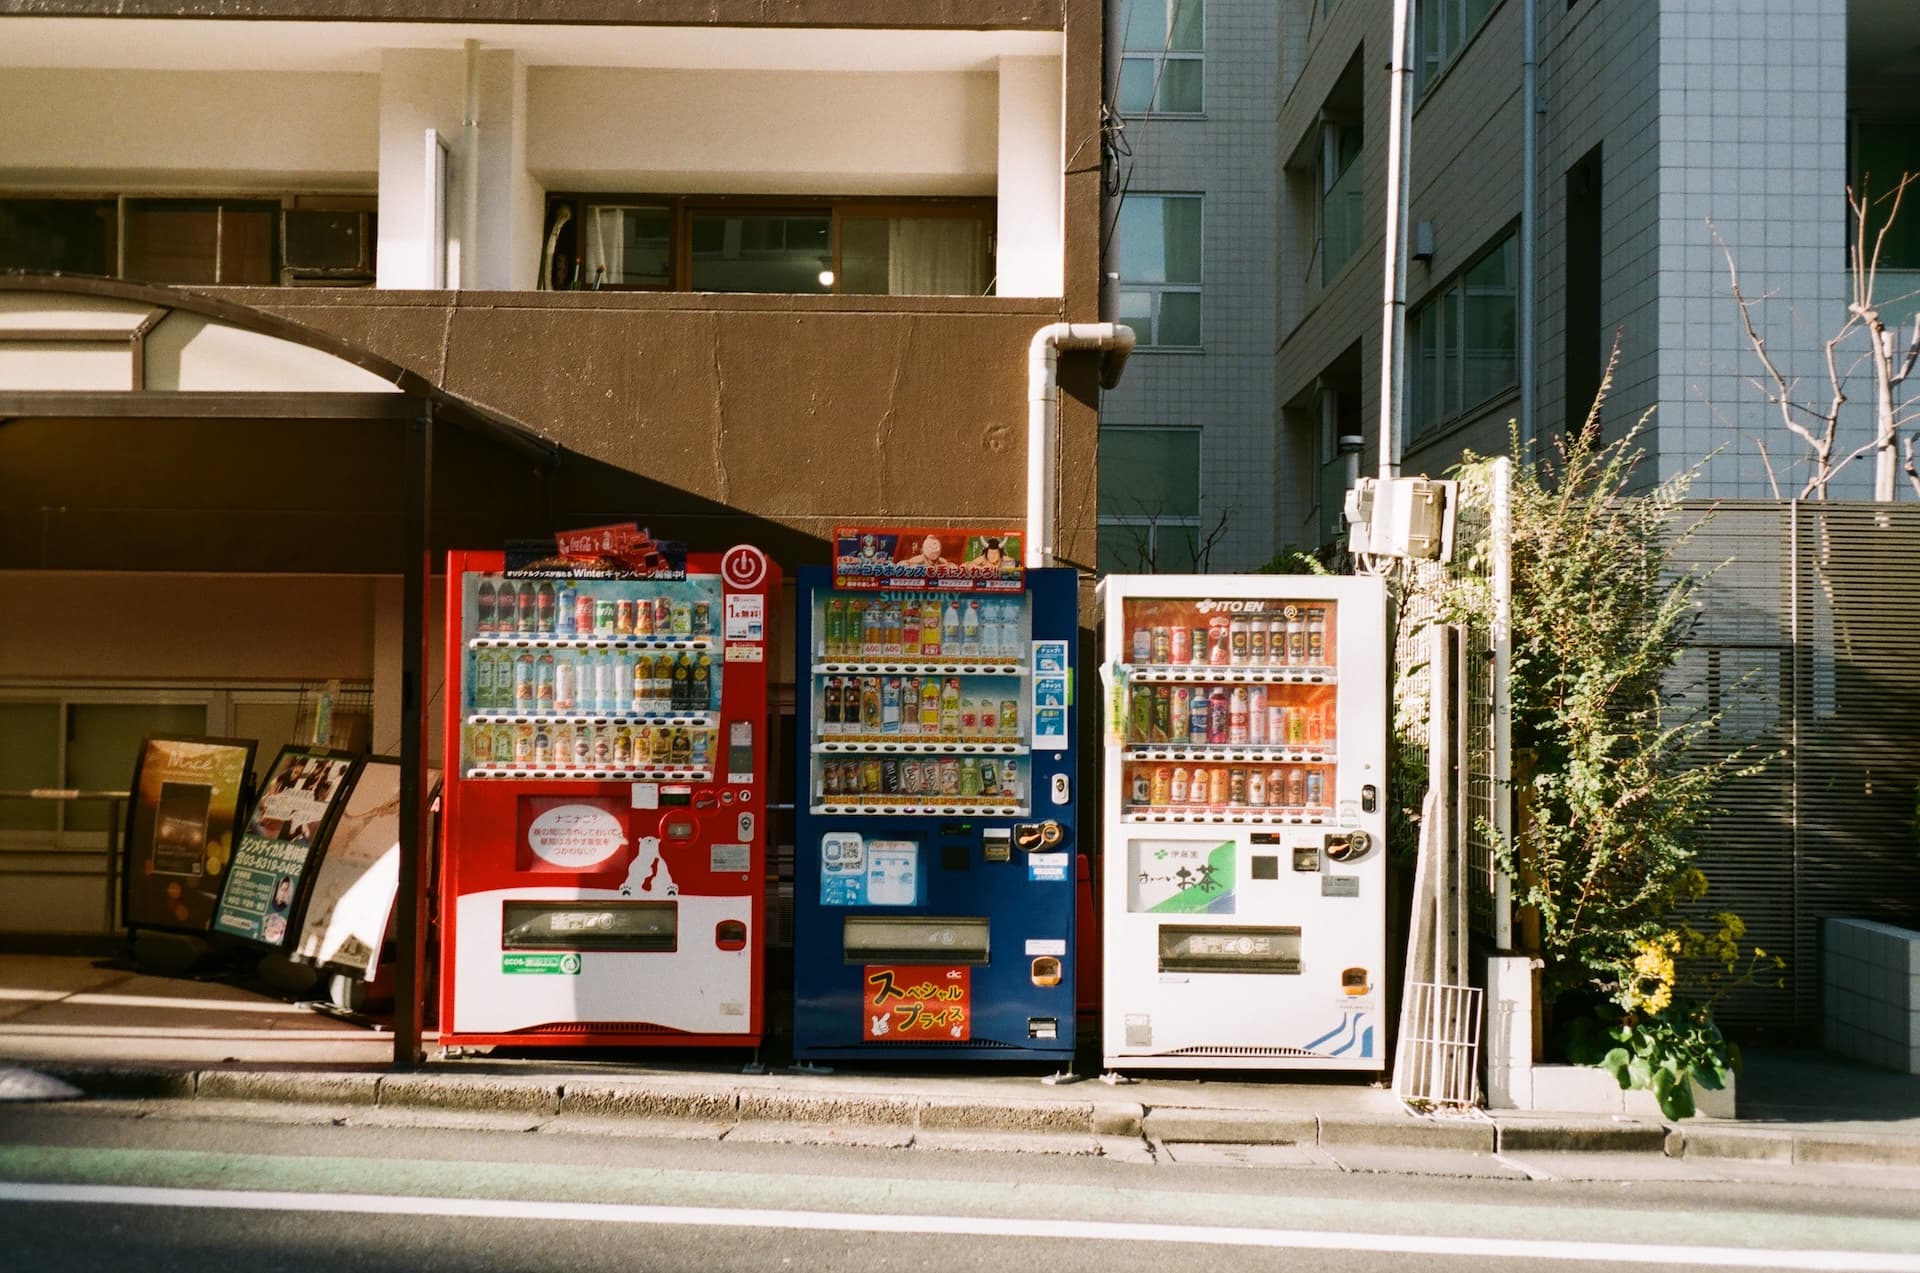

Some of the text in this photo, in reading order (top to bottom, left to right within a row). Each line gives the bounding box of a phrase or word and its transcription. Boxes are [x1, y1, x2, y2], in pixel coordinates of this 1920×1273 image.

[1215, 601, 1264, 612] ITO EN
[869, 969, 964, 1006] スペシャル
[894, 1001, 965, 1031] プライス
